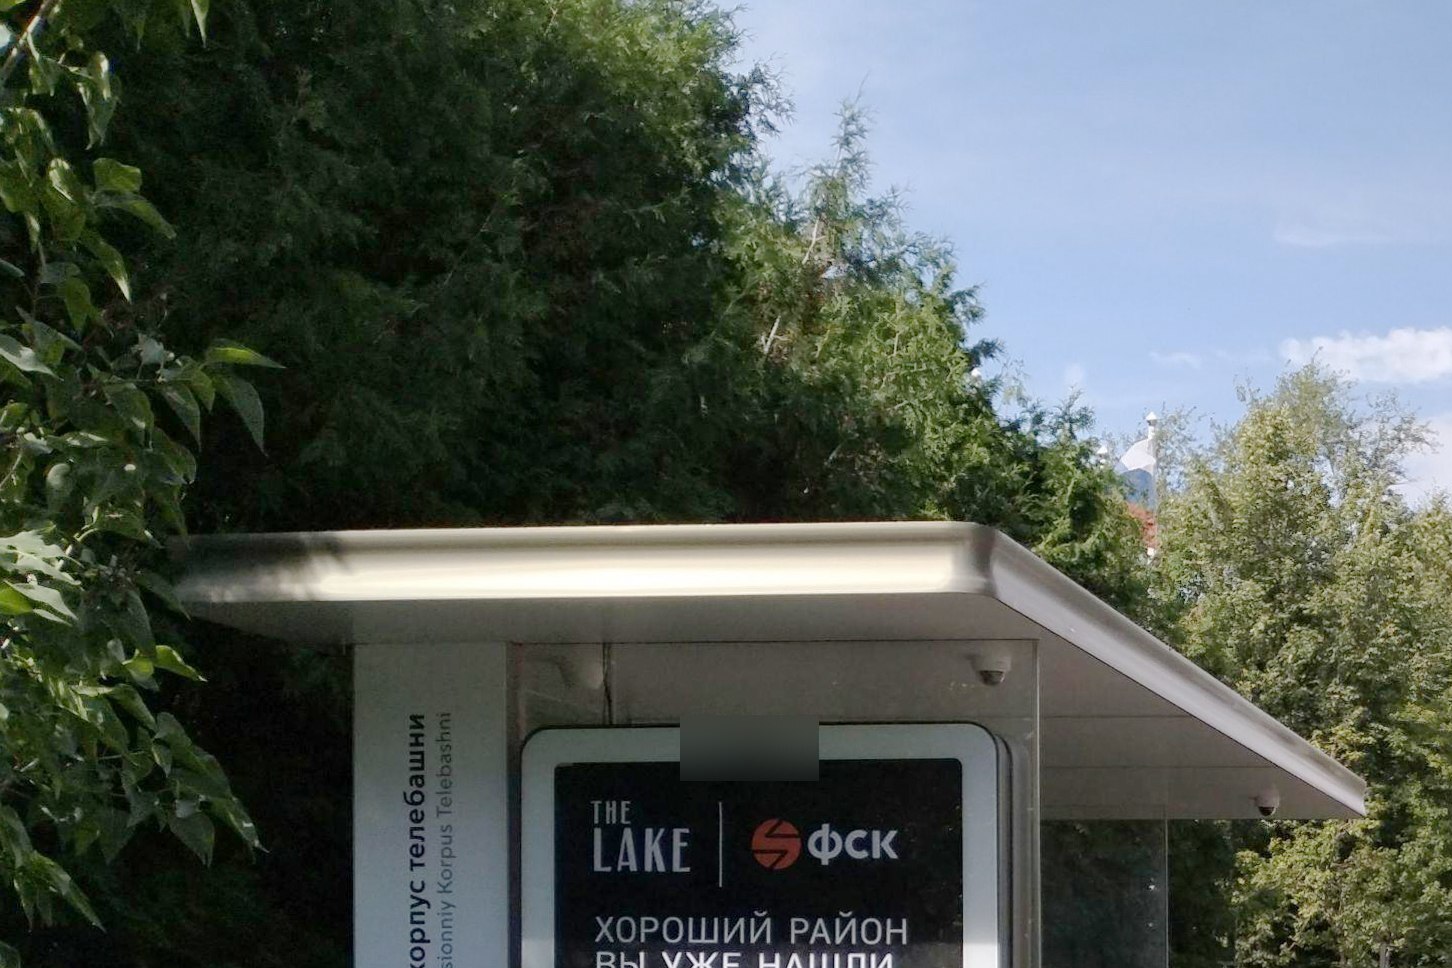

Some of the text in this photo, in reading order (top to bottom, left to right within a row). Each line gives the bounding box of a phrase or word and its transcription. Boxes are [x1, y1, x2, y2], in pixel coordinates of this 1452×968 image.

[402, 713, 426, 873] телебашни
[435, 712, 453, 818] Telebashni
[591, 800, 631, 825] THE
[436, 823, 457, 894] Korpus
[593, 827, 691, 873] LAKE
[595, 911, 908, 945] ХОРОШИЙ РАЙОН
